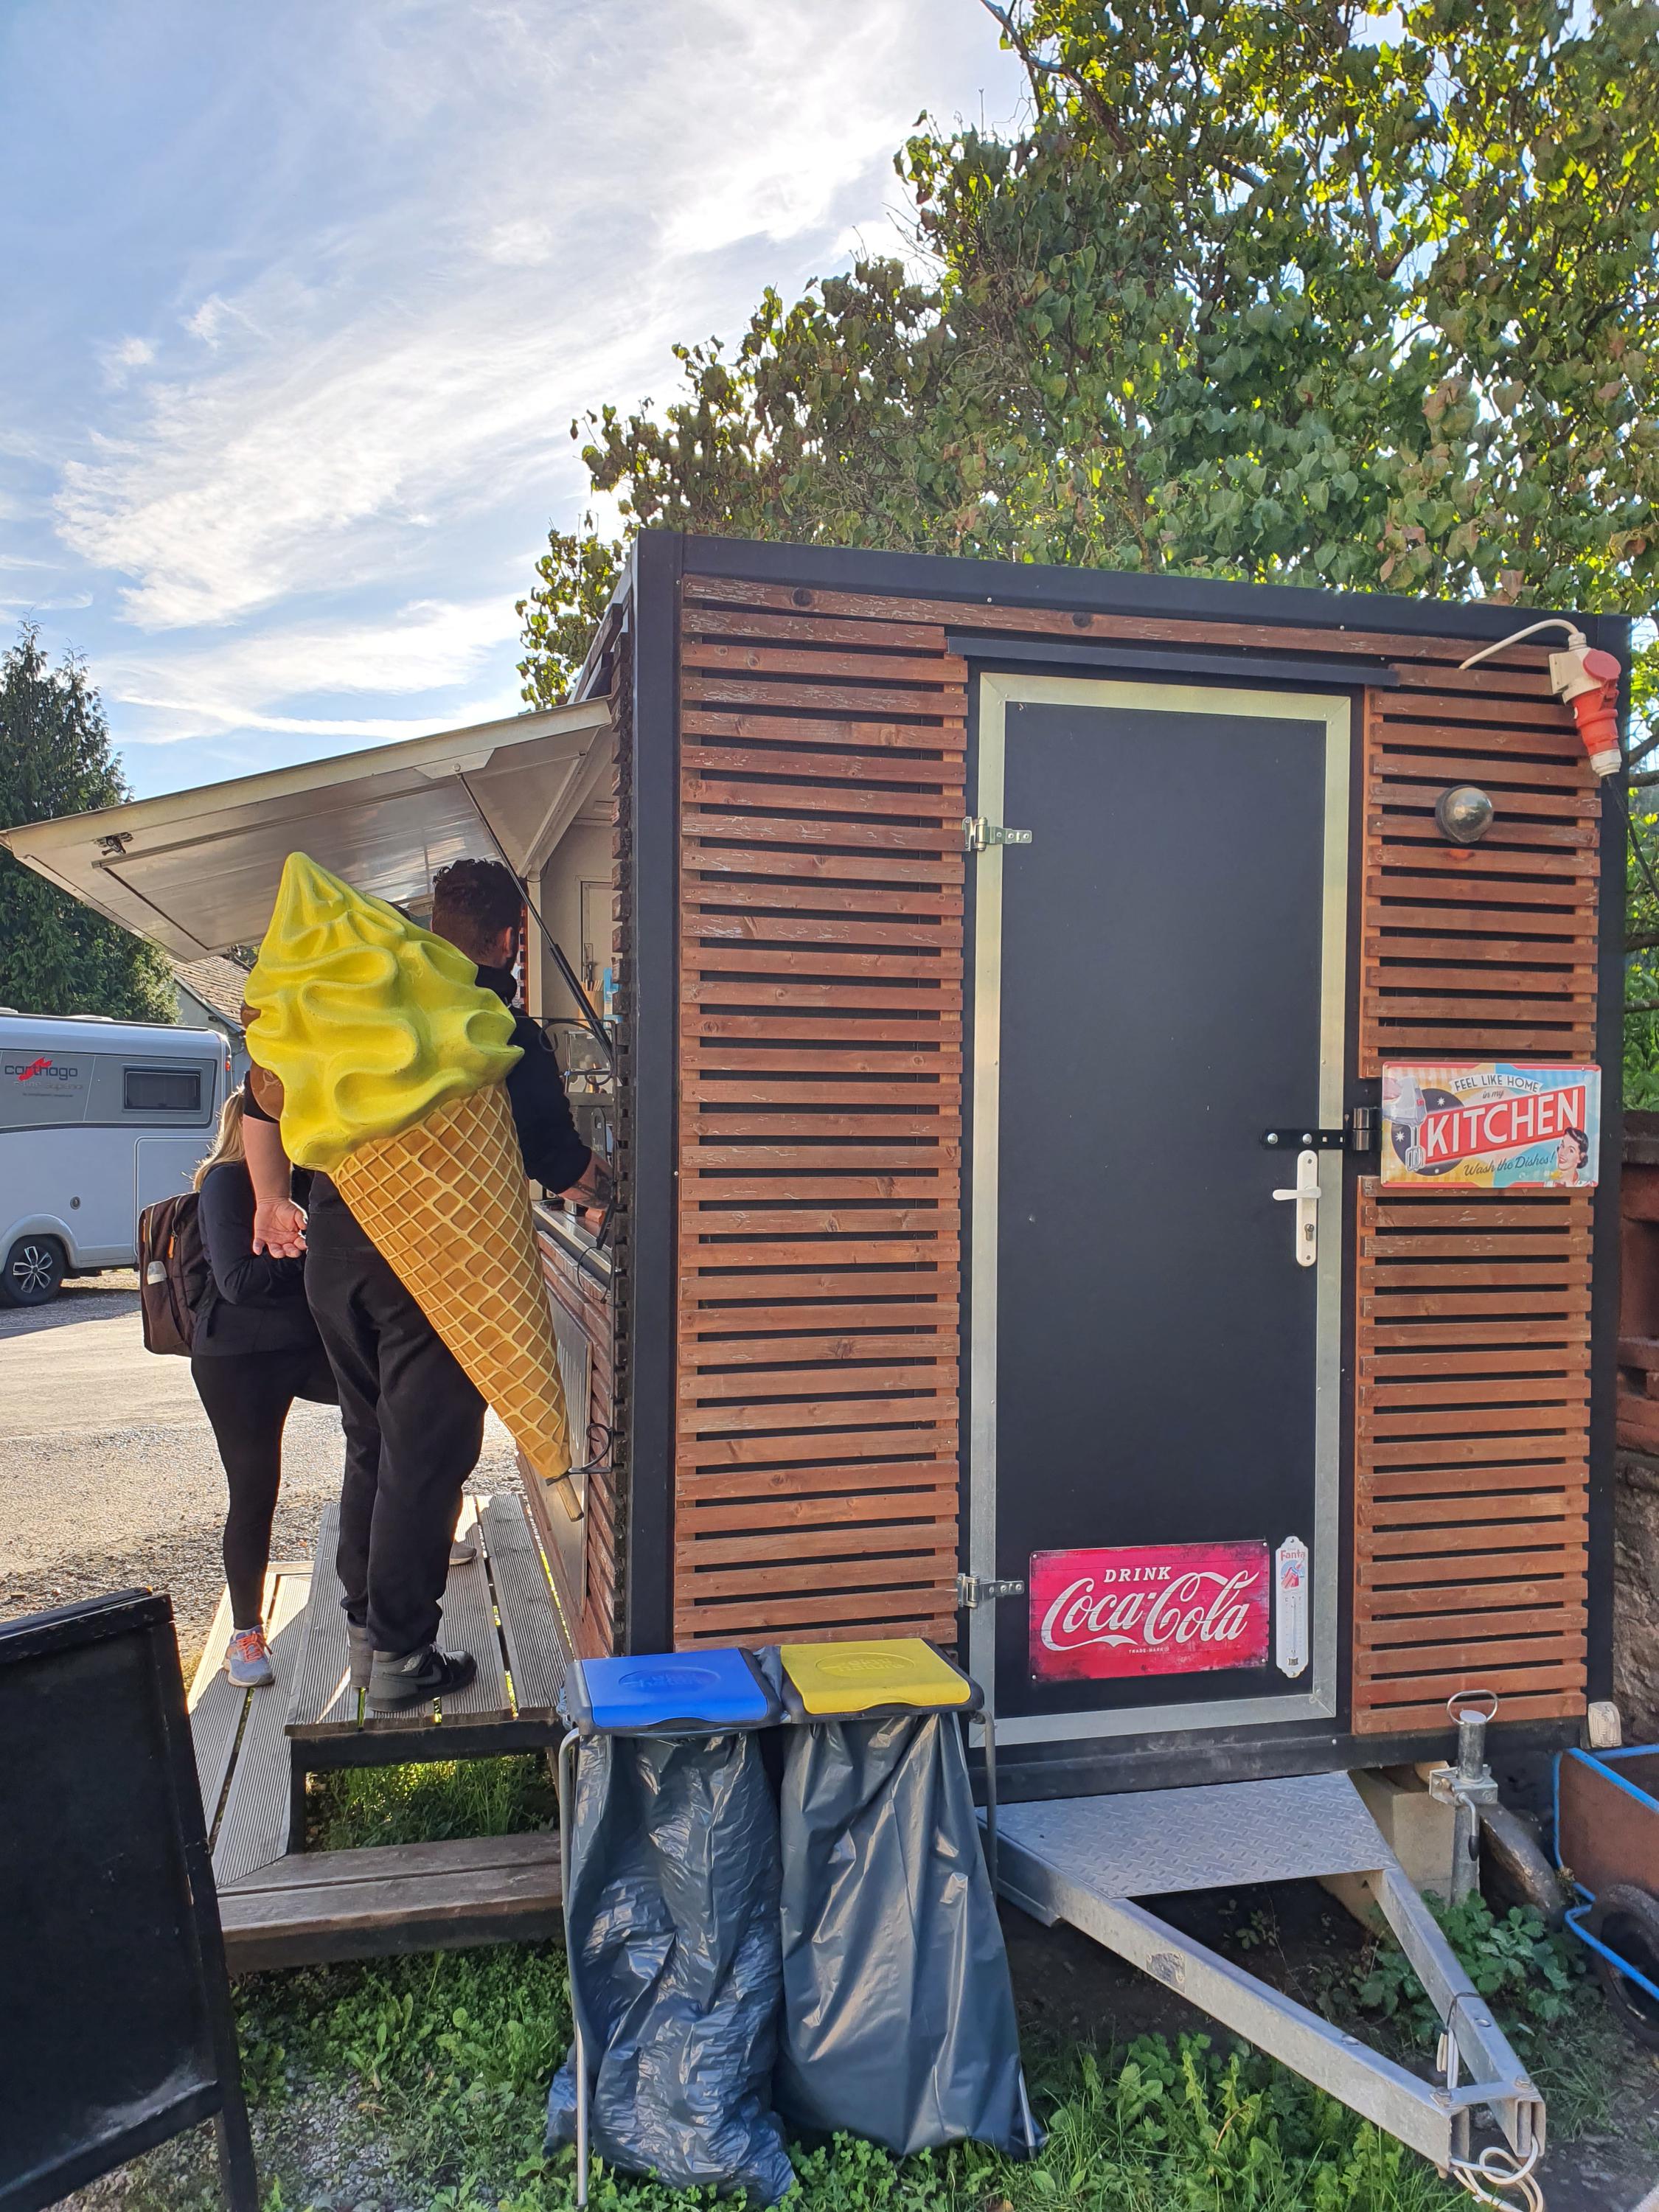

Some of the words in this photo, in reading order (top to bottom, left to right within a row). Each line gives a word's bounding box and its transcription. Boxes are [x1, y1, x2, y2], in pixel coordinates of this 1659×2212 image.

[1454, 1077, 1478, 1092] FEEL
[1481, 1075, 1502, 1085] LIKE
[1507, 1076, 1539, 1093] HOME
[1427, 1088, 1579, 1158] KITCHEN
[1464, 1160, 1495, 1176] Wash
[1497, 1158, 1513, 1171] the
[1515, 1150, 1556, 1169] Dishes!
[1280, 1549, 1305, 1561] Fanta
[1103, 1566, 1172, 1583] DRINK
[1040, 1570, 1259, 1652] Coca-Cola
